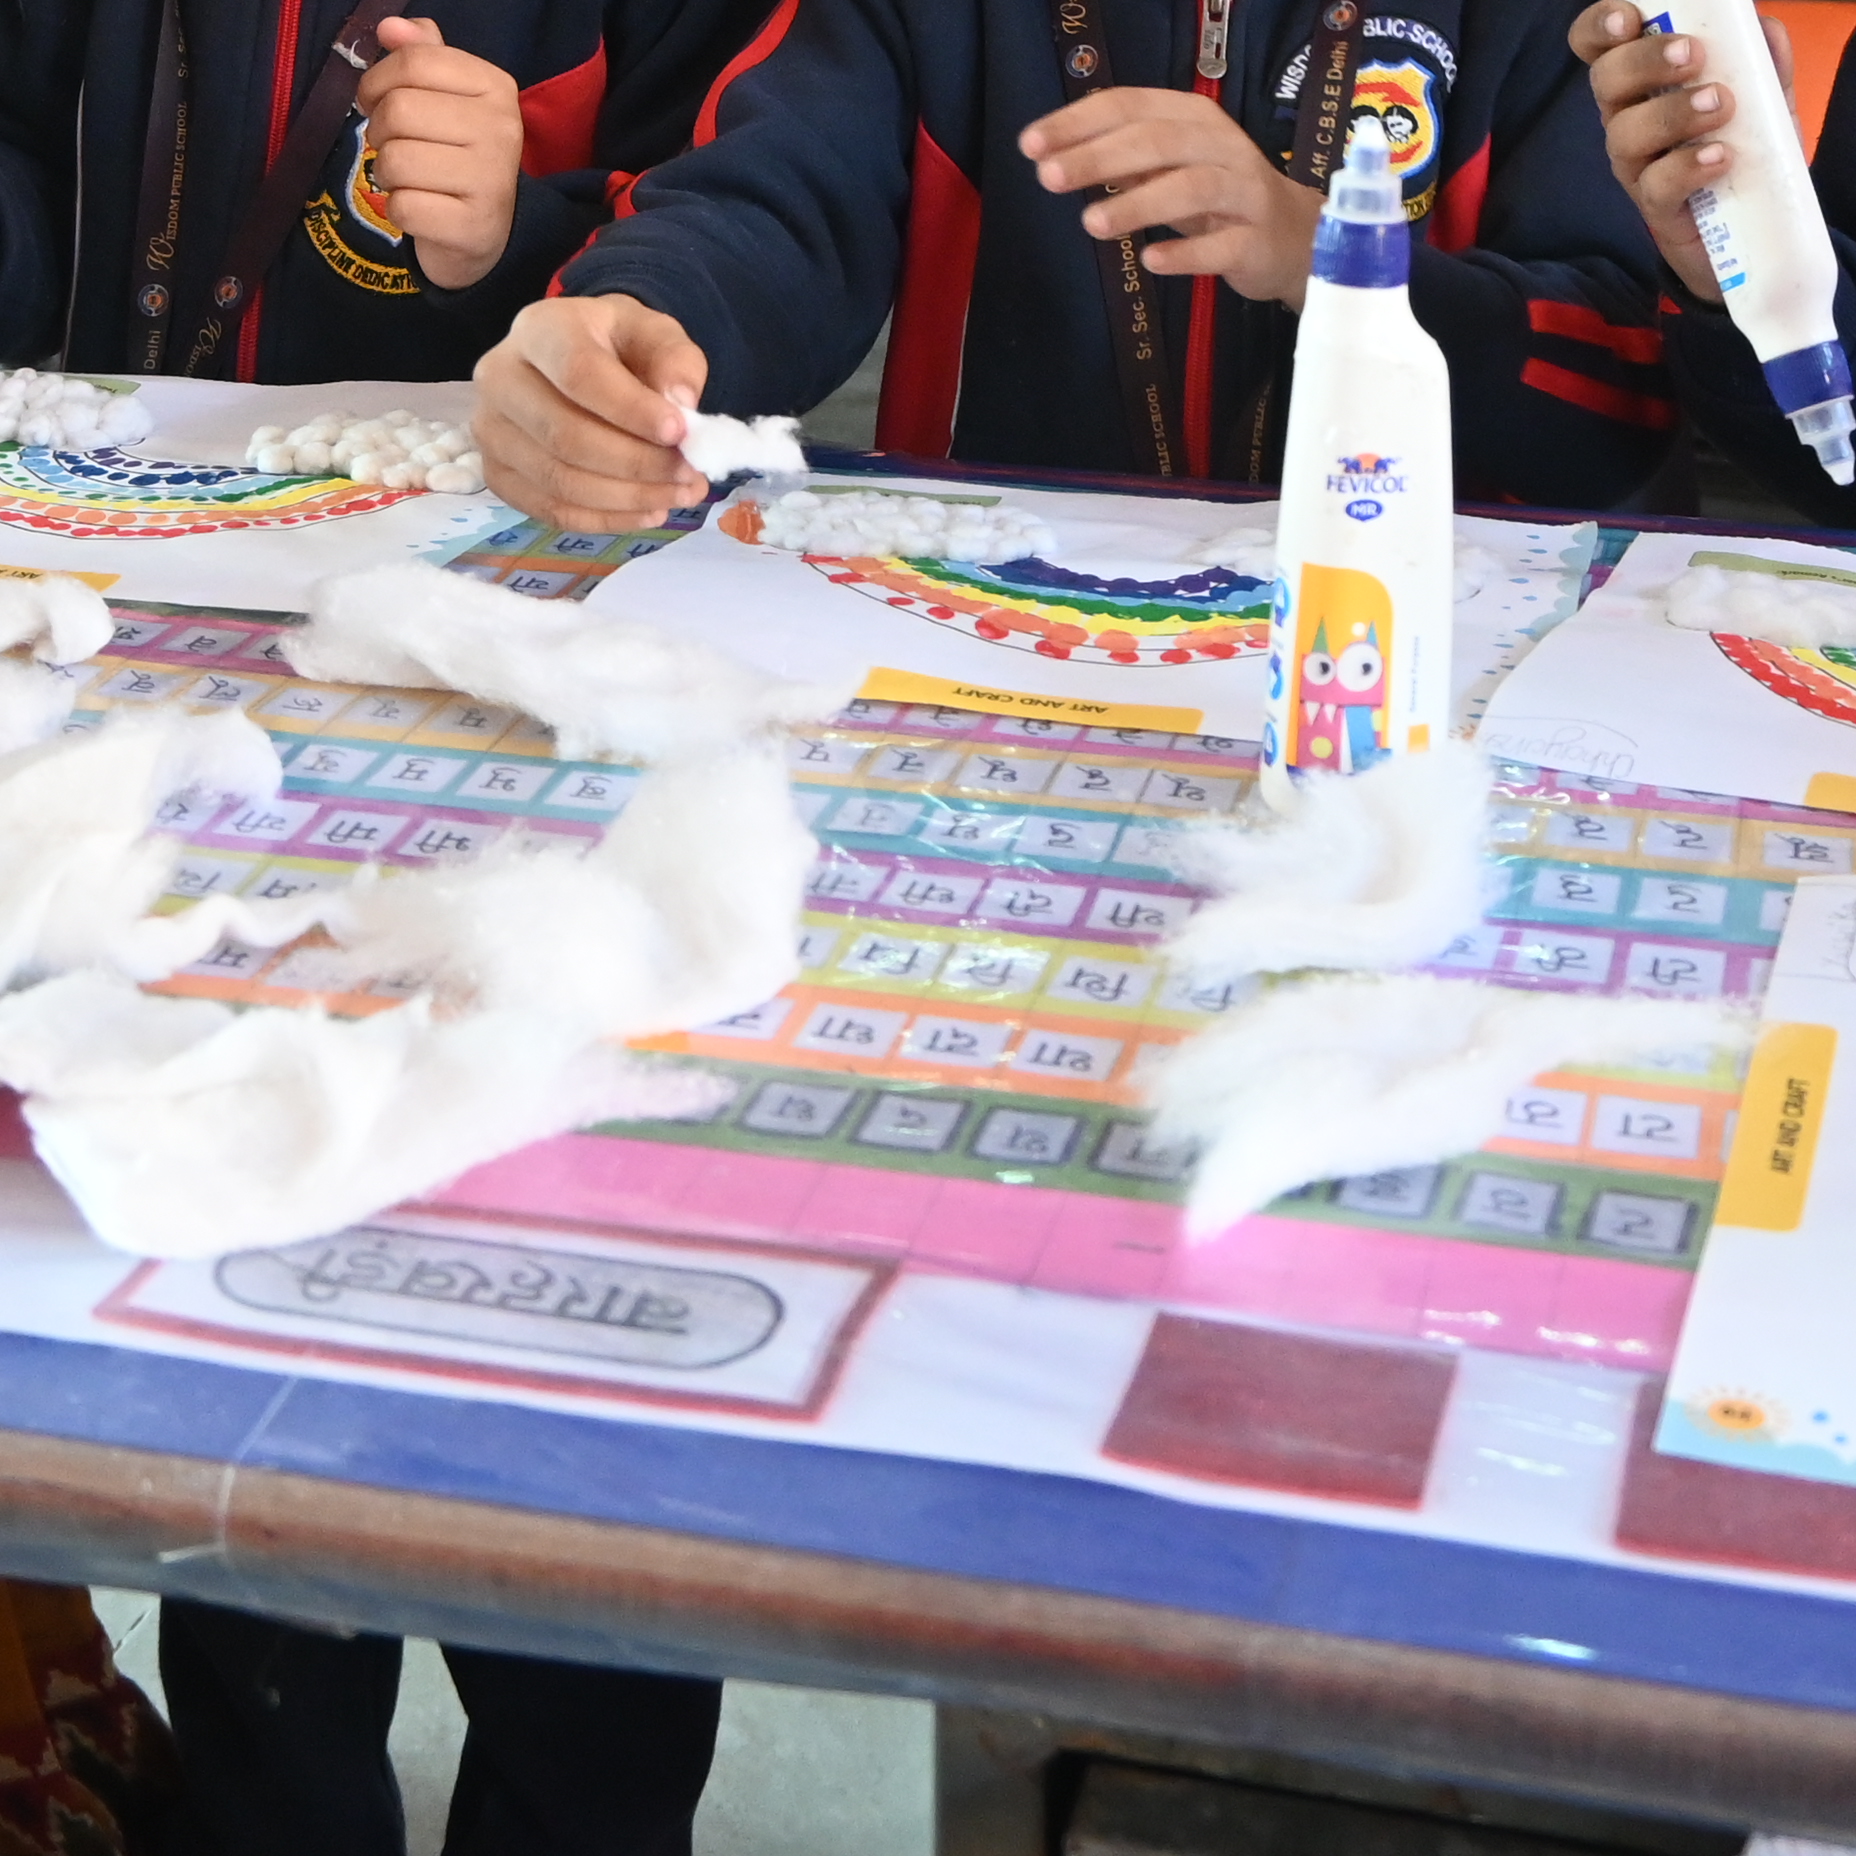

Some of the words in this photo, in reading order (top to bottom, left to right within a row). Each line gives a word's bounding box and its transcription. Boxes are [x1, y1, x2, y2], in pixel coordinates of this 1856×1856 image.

[1362, 16, 1407, 40] BLIC
[1326, 40, 1349, 82] Delhi
[175, 101, 189, 156] SCHOOL
[171, 154, 185, 198] PUBLIC
[146, 197, 180, 271] WISDOM
[143, 329, 161, 370] Delhi
[185, 317, 222, 377] WISDO
[1326, 474, 1409, 494] FEVICOL
[1351, 502, 1378, 516] MR
[5, 570, 44, 580] ART
[951, 687, 1015, 703] CRAFT
[1019, 698, 1065, 709] AND
[1068, 704, 1110, 714] ART
[391, 758, 435, 782] मु
[478, 767, 522, 792] भु
[977, 756, 1019, 783] धू
[1160, 774, 1206, 802] थू
[232, 810, 288, 833] यी
[323, 821, 379, 844] मी
[412, 830, 471, 854] भी
[1656, 821, 1709, 851] टू
[898, 880, 956, 907] धी
[1000, 890, 1054, 917] दी
[1105, 902, 1166, 929] थी
[1063, 967, 1130, 1002] थि
[1642, 958, 1703, 985] टी
[812, 1017, 875, 1045] धा
[924, 1028, 981, 1057] दा
[1027, 1043, 1095, 1073] था
[1616, 1113, 1681, 1144] टा
